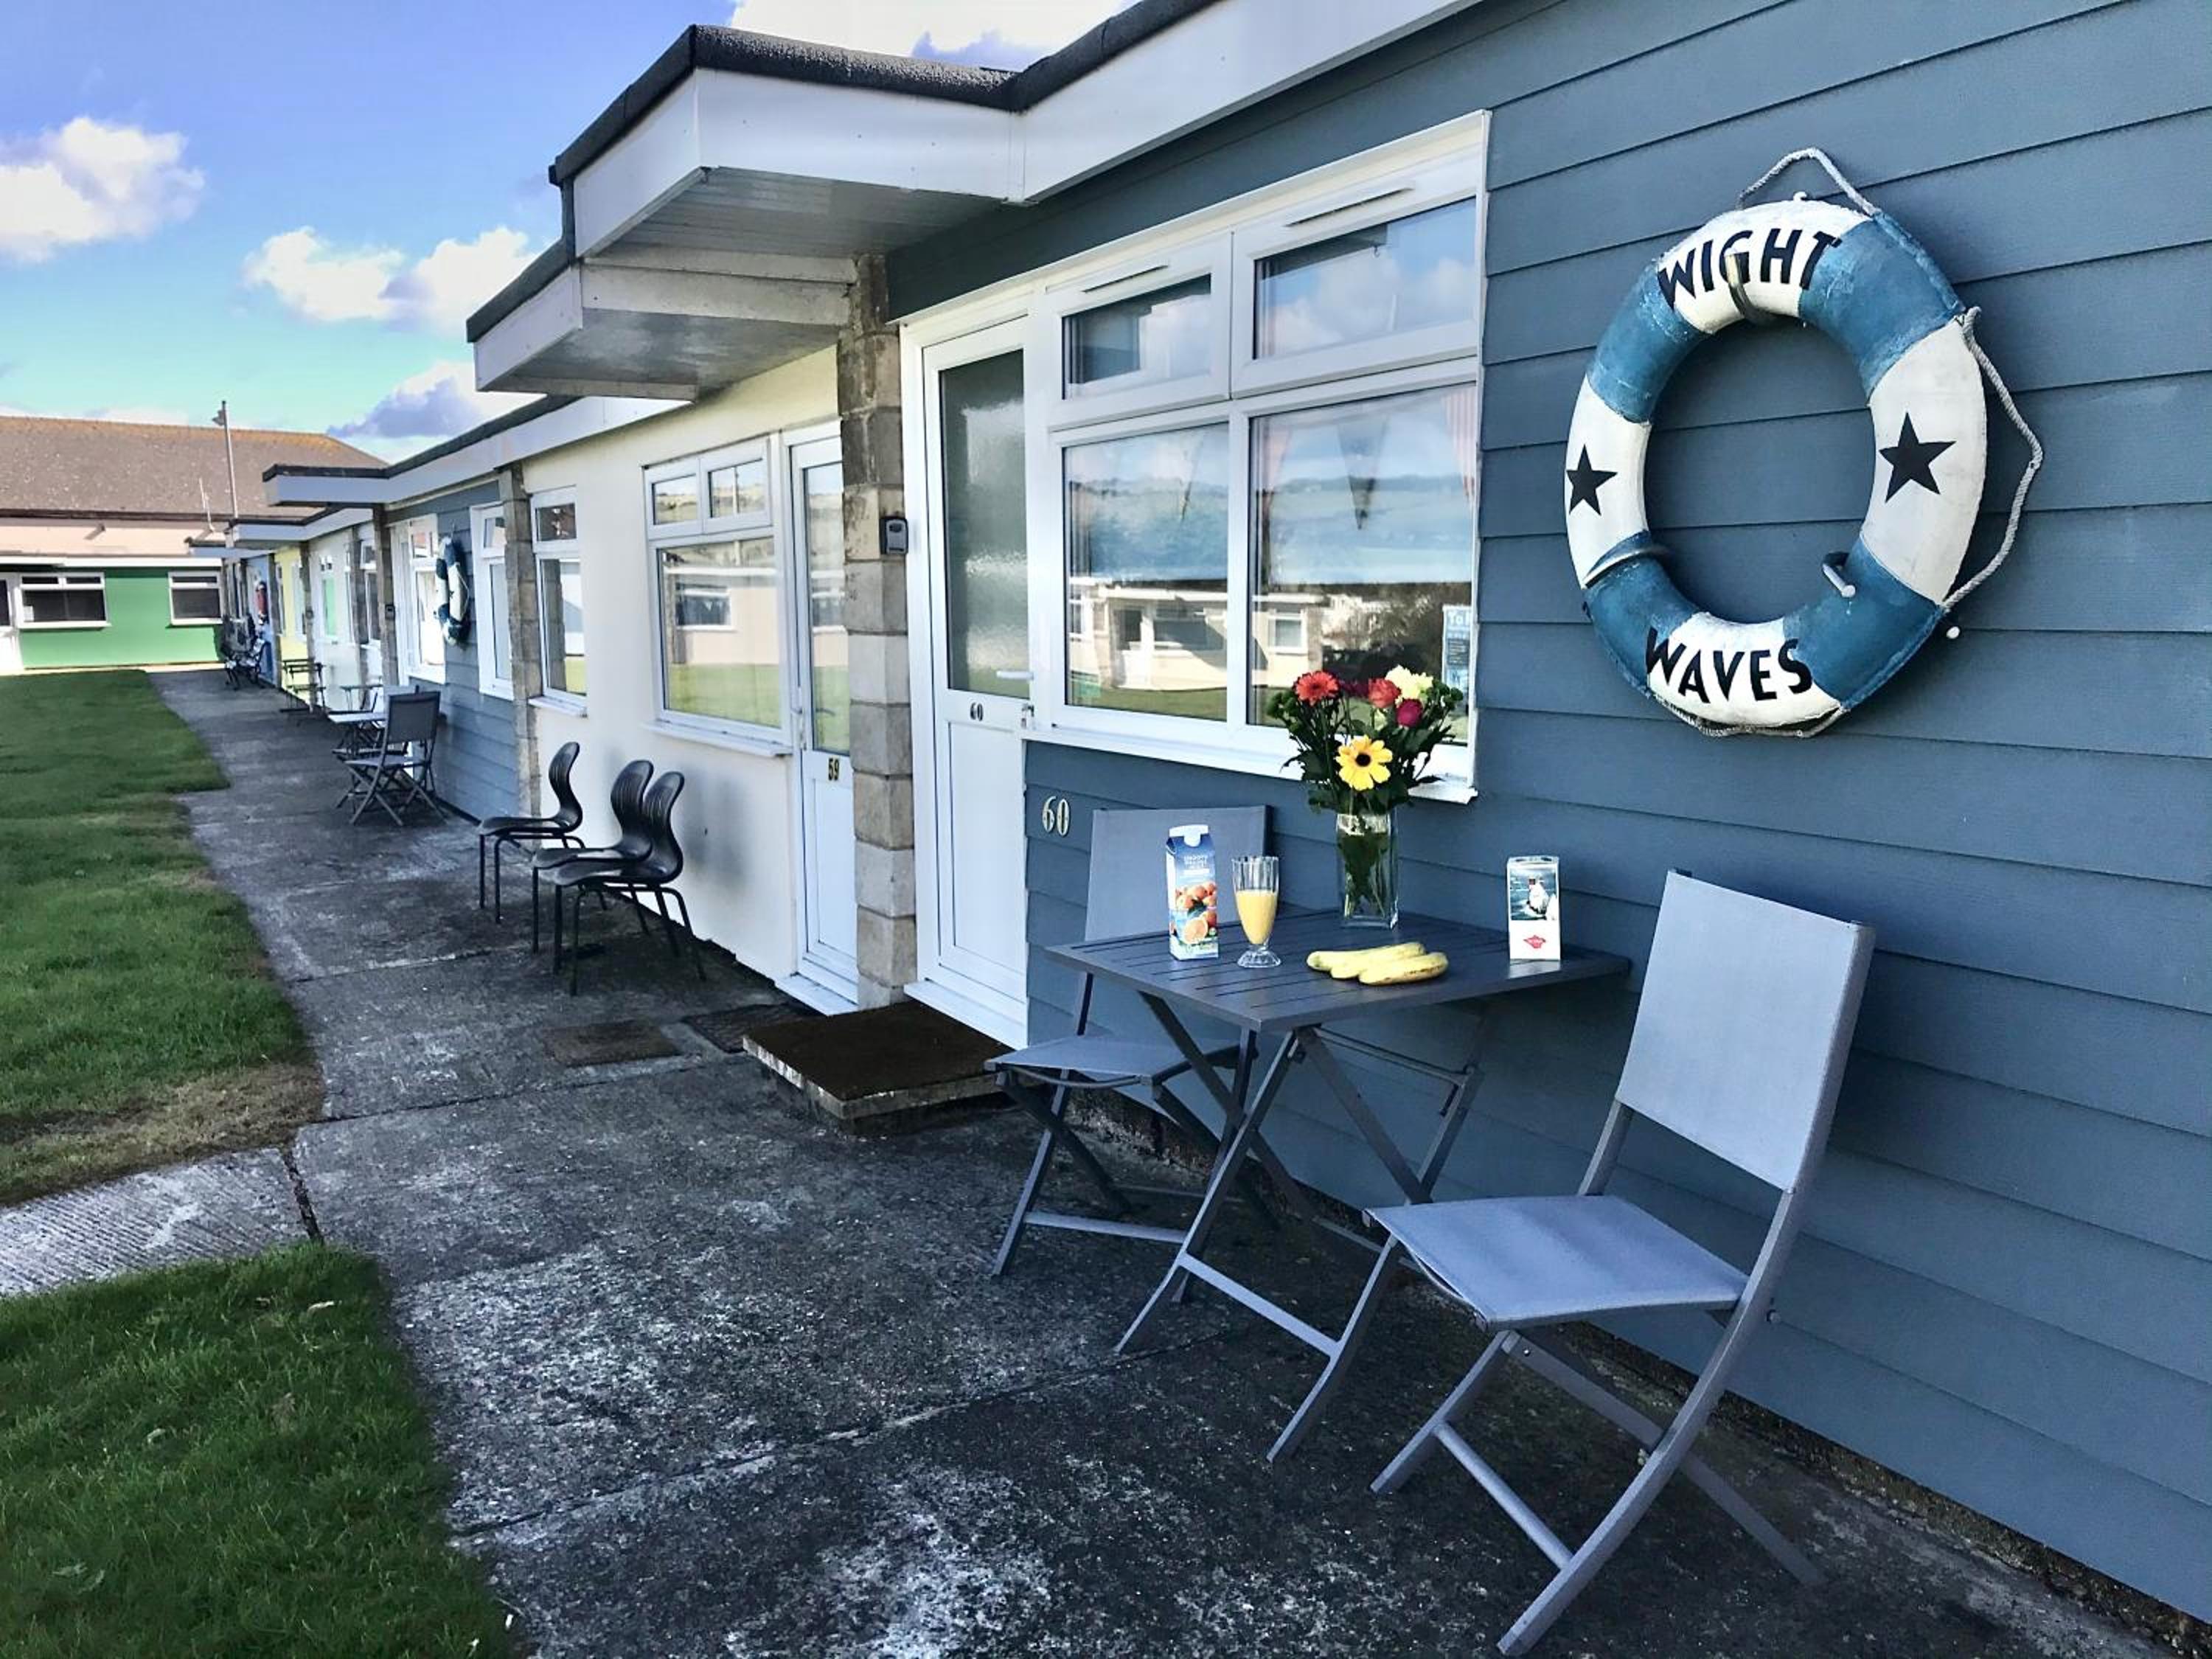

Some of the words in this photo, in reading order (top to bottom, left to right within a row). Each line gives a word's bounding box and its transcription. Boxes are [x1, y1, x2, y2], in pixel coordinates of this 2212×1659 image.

[1658, 228, 1843, 312] WIGHT
[1645, 627, 1813, 703] WAVES
[970, 702, 984, 721] 60
[828, 757, 840, 781] 59
[1042, 796, 1070, 836] 60
